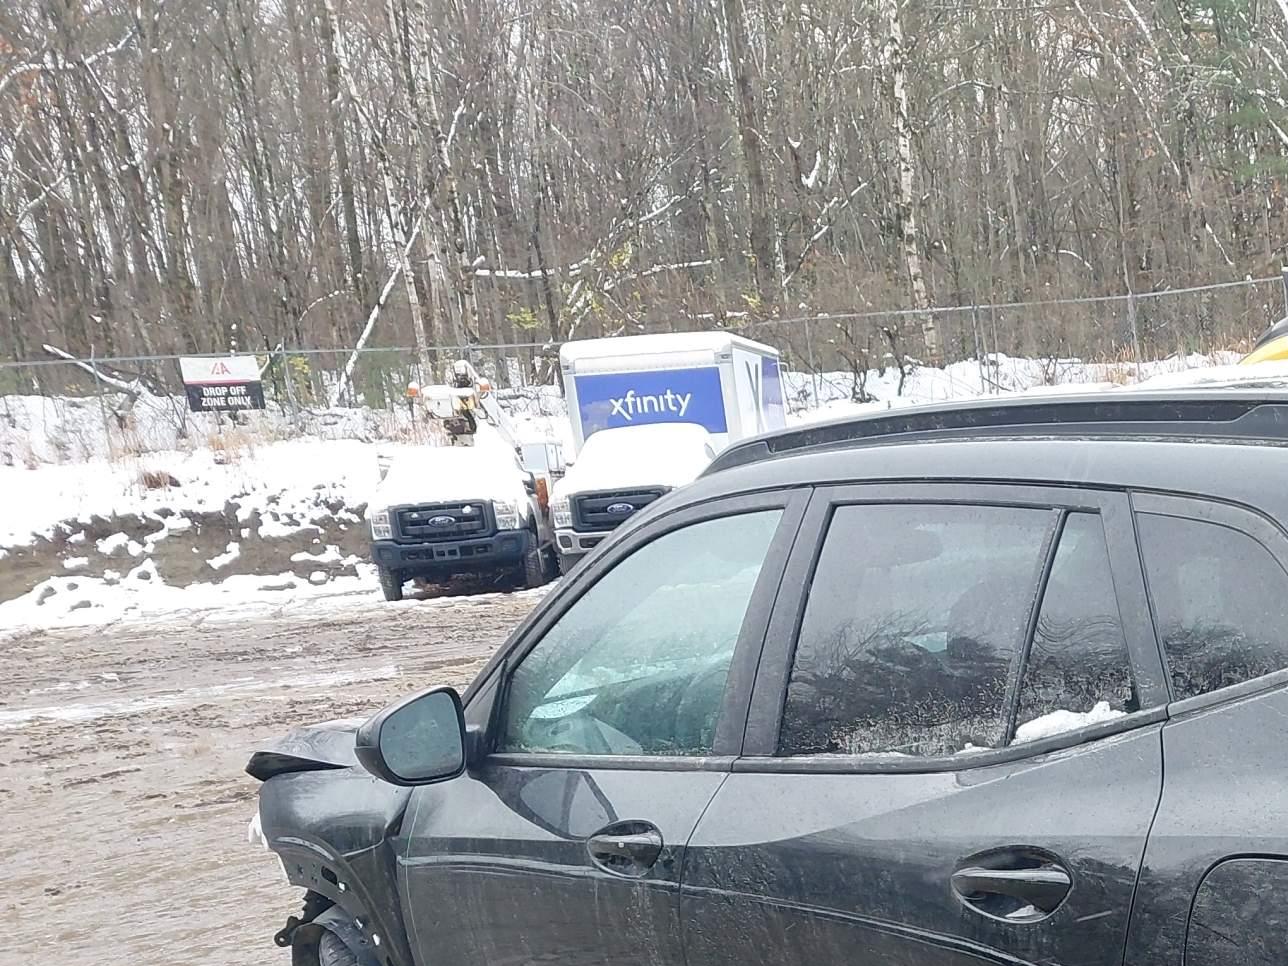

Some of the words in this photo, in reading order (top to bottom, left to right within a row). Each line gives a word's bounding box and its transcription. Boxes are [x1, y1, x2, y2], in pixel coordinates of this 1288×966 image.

[202, 386, 228, 396] DROP
[229, 385, 246, 396] OFF
[200, 396, 227, 406] ZONE
[227, 395, 251, 406] ONLY
[609, 389, 691, 421] xfinity
